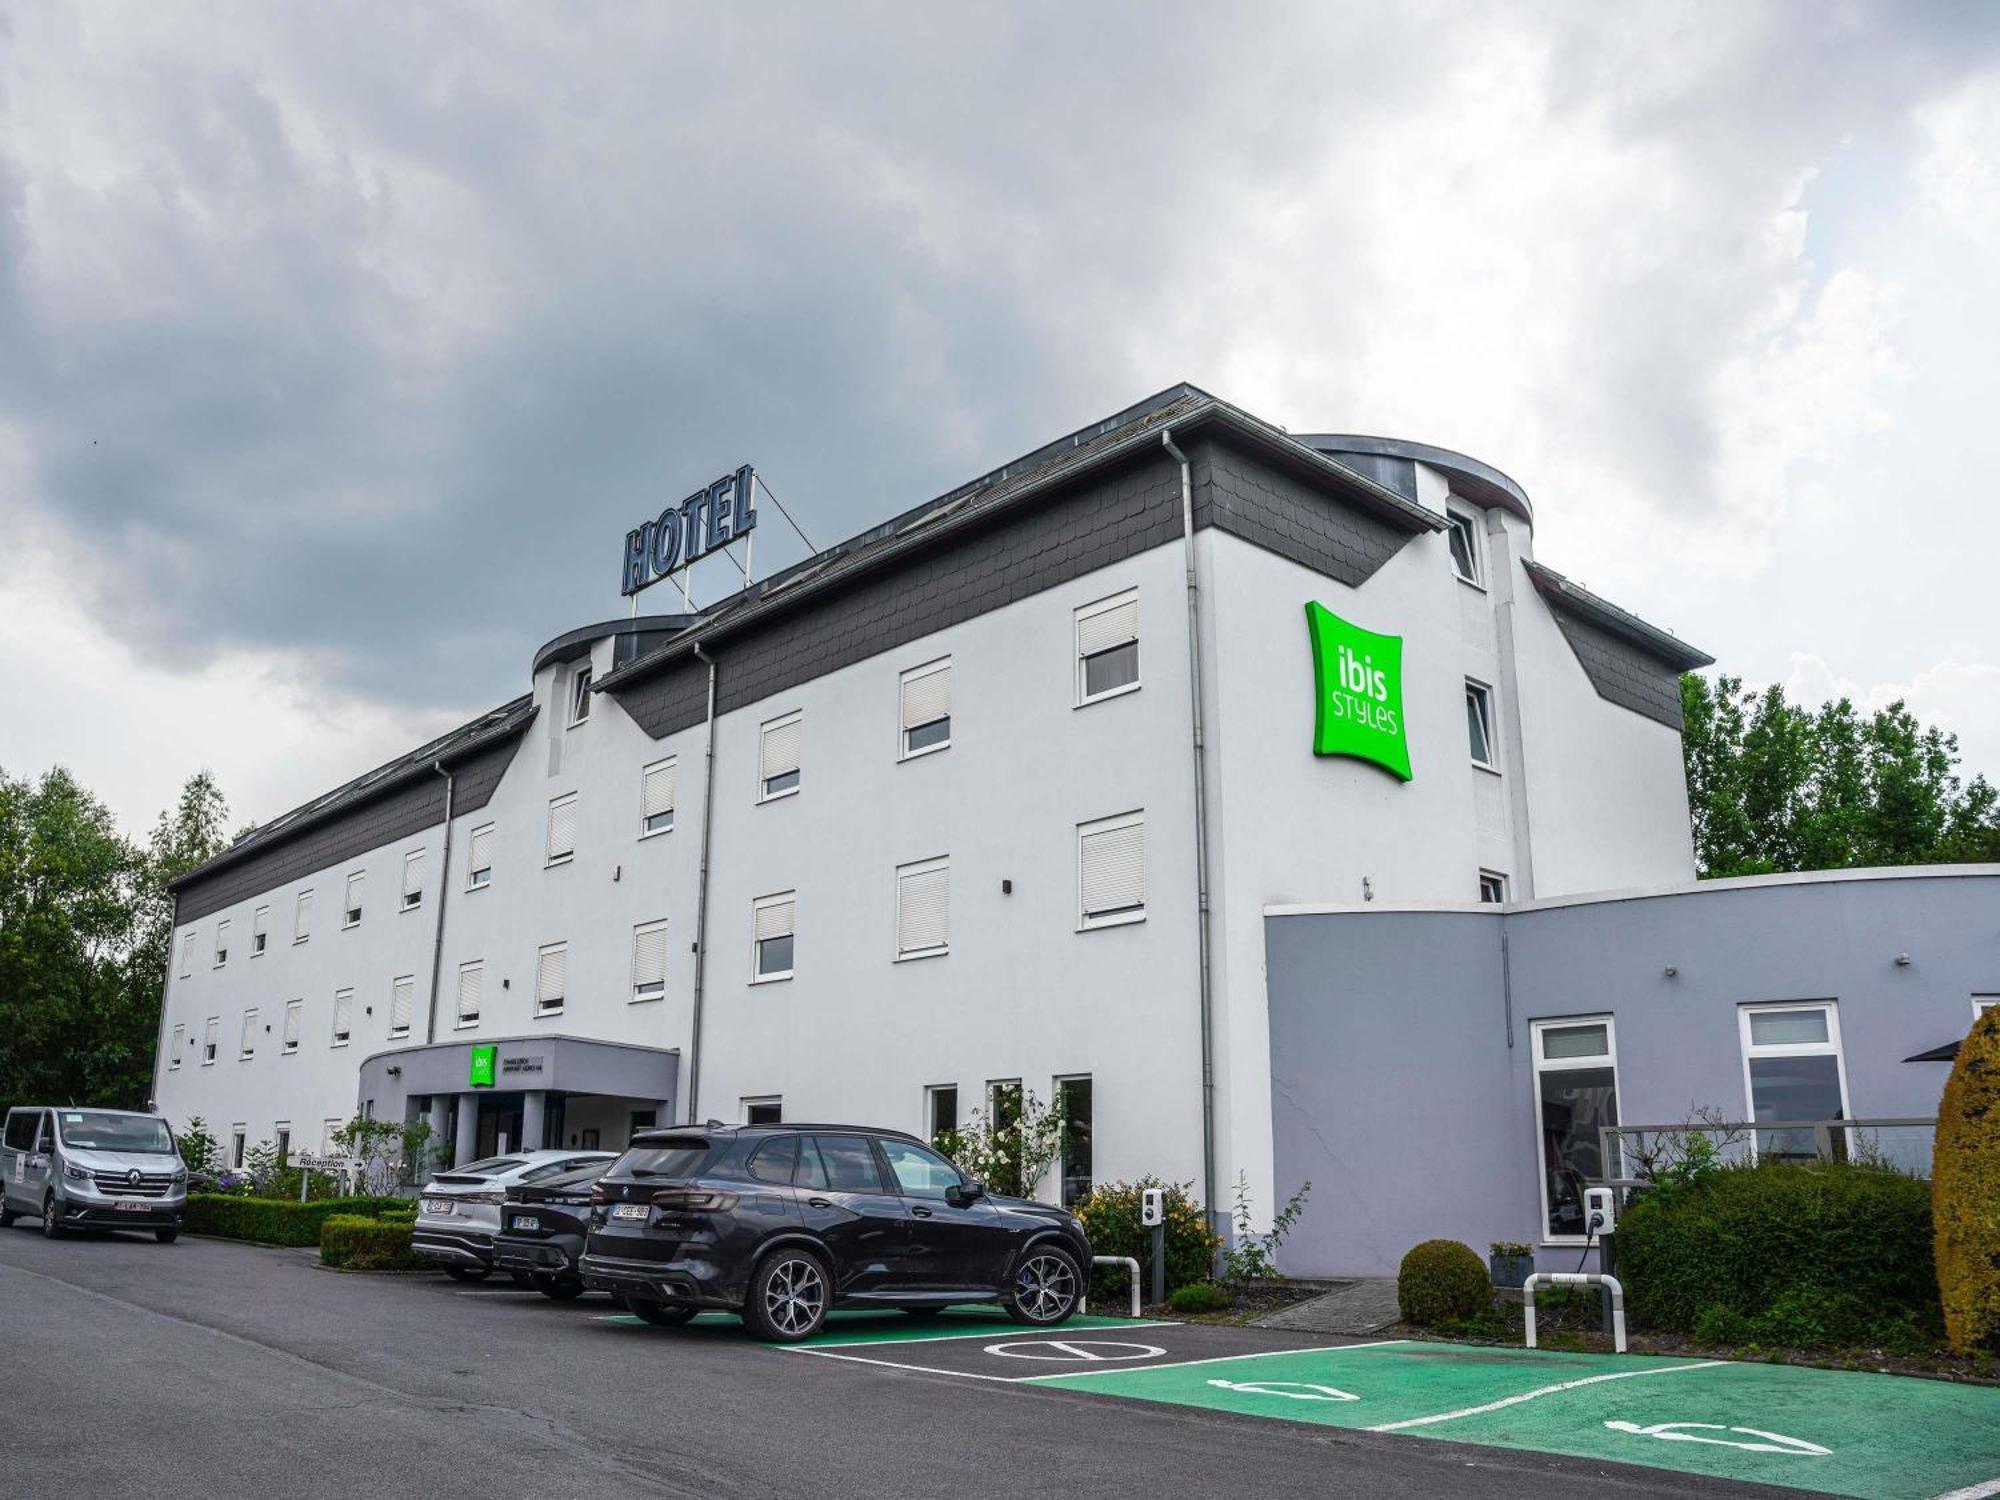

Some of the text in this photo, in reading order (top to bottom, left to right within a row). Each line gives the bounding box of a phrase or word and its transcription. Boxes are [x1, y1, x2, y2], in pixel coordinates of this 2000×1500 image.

[621, 464, 757, 596] HOTEL
[1338, 644, 1387, 702] ibis
[299, 1158, 345, 1168] Reception
